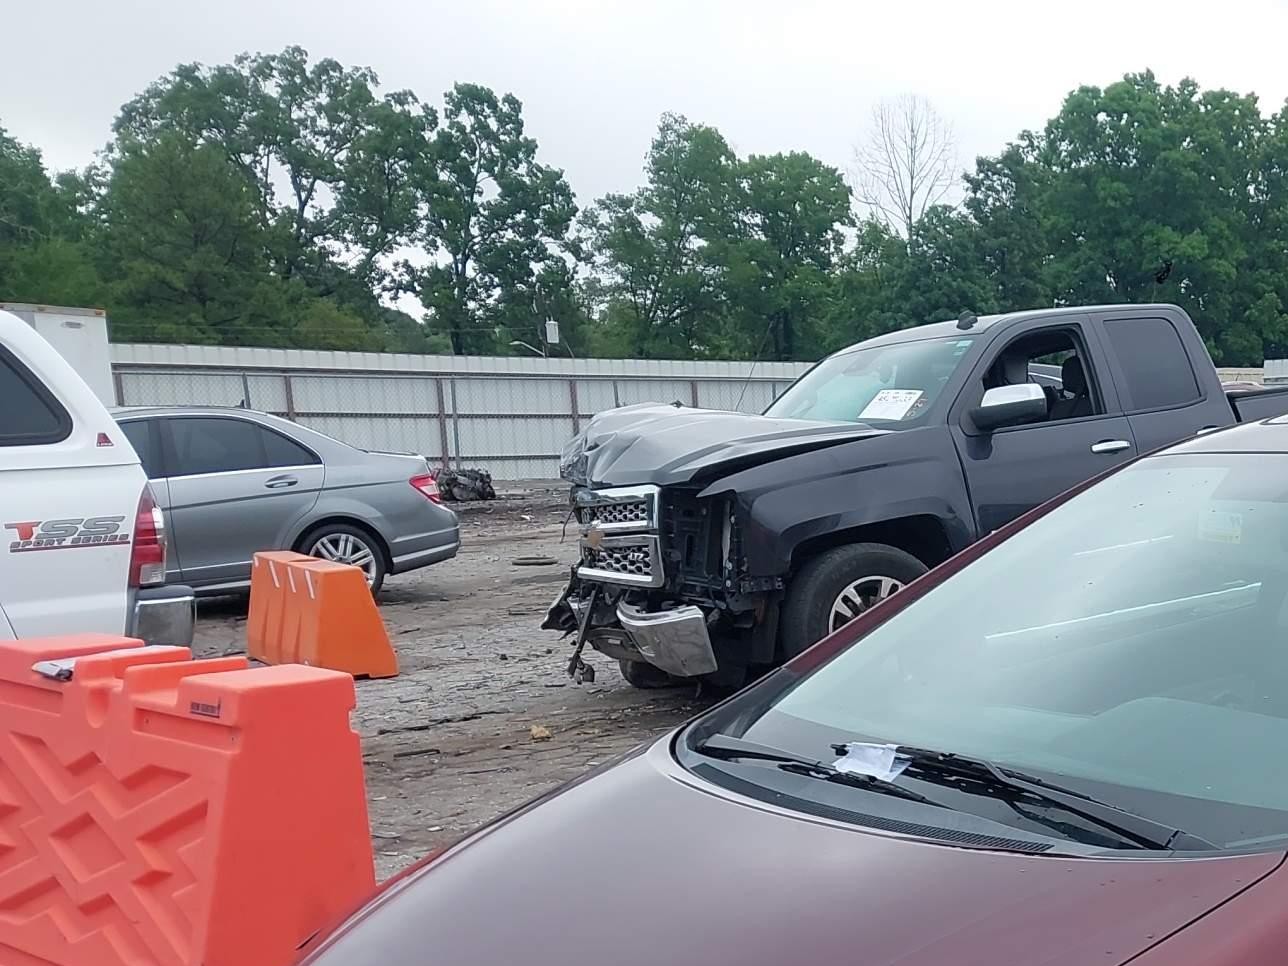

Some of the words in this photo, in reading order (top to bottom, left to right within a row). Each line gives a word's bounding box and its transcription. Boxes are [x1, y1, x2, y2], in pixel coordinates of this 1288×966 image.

[4, 515, 126, 541] TSS
[10, 538, 67, 549] SPORT
[71, 533, 130, 545] SERIES
